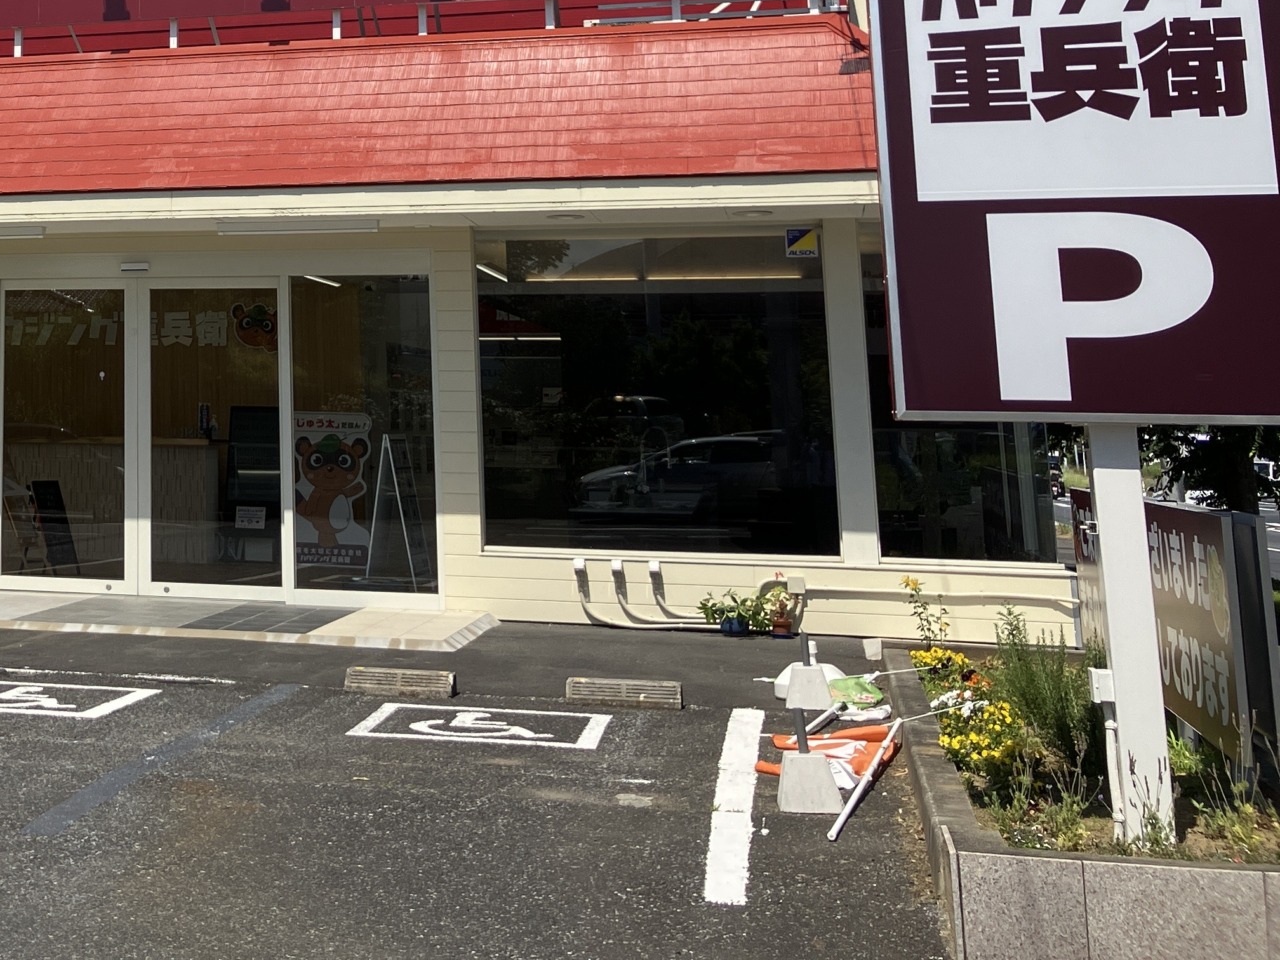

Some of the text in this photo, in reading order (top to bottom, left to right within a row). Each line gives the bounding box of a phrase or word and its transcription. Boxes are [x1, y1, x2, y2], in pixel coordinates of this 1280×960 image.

[926, 17, 1248, 124] 重兵衛
[986, 211, 1214, 402] P
